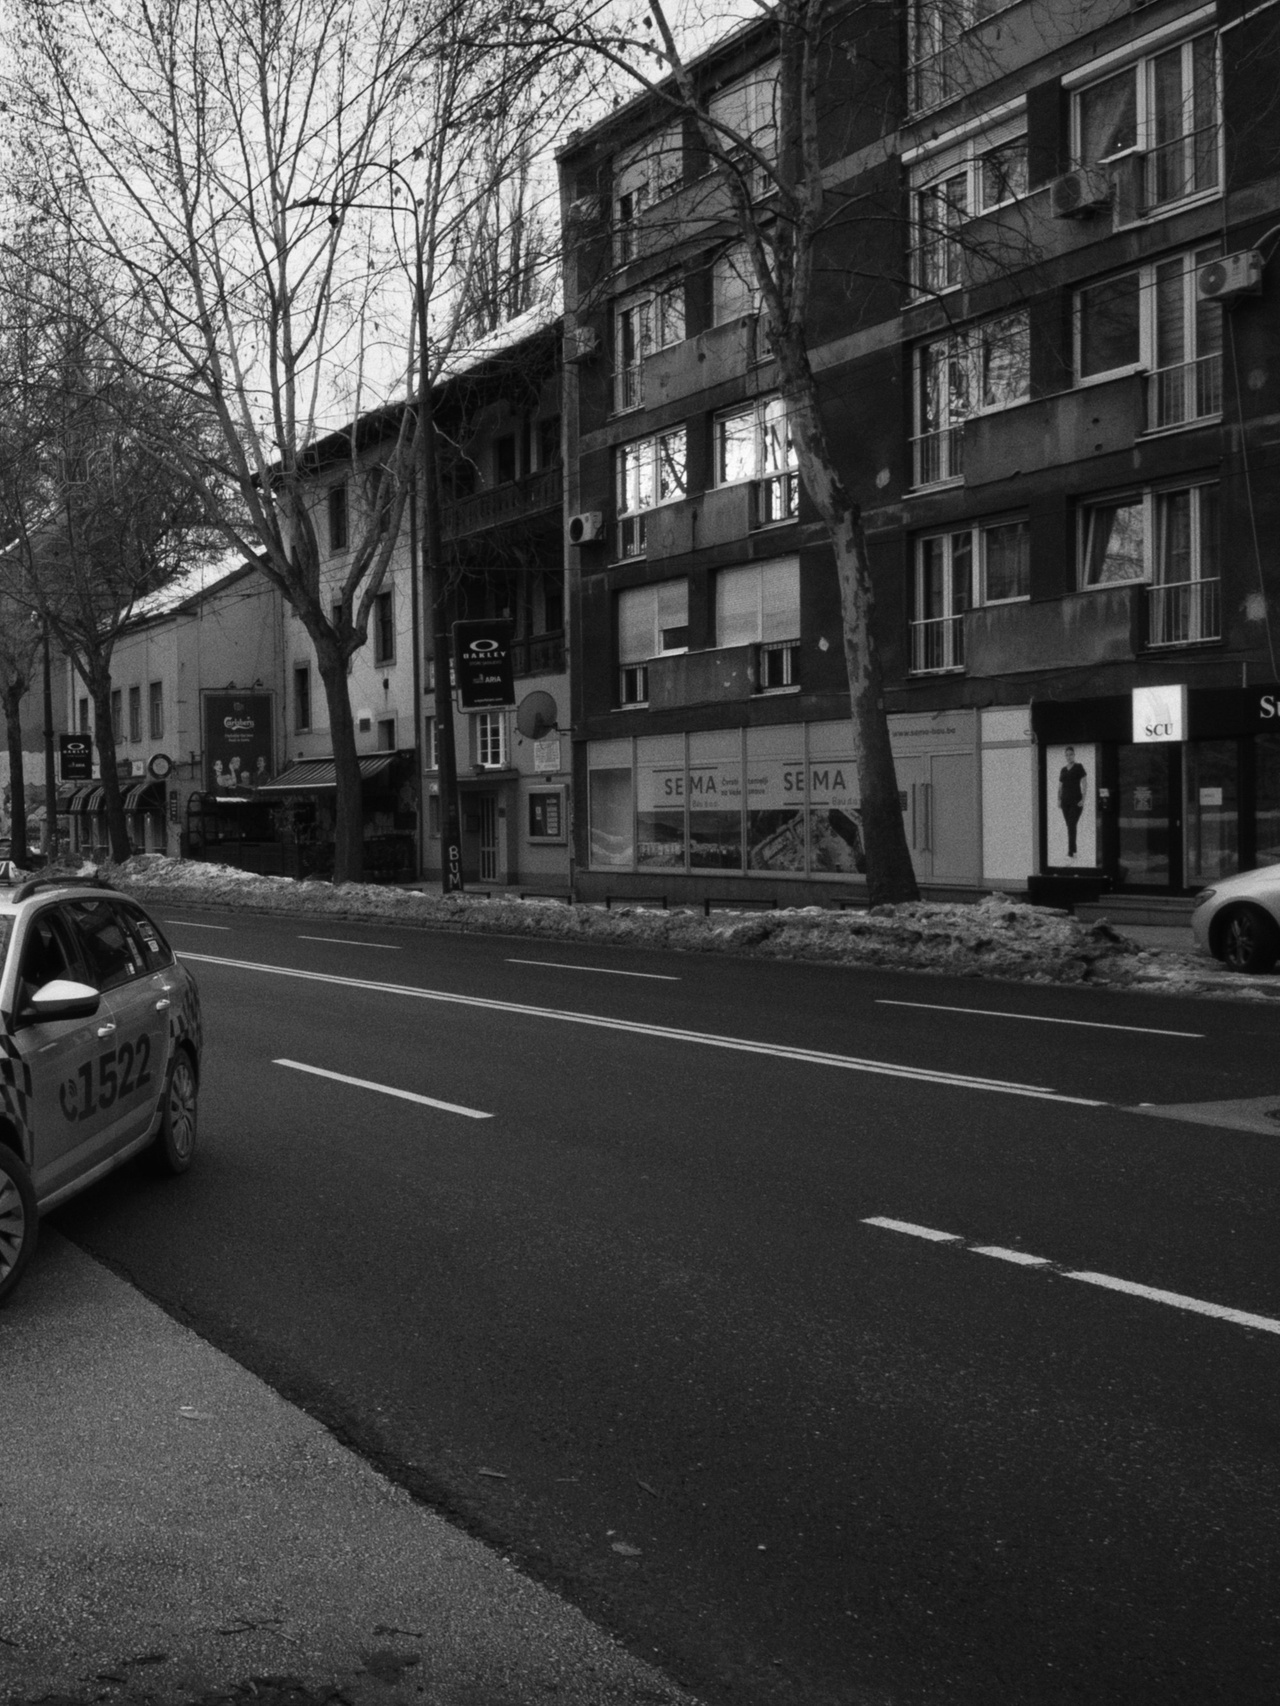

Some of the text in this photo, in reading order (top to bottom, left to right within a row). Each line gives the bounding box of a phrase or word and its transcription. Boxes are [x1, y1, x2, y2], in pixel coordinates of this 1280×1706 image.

[462, 650, 506, 659] OAKLEY
[1145, 723, 1174, 737] SCU
[664, 775, 718, 796] SEMA
[783, 769, 846, 791] SEMA
[78, 1033, 150, 1121] 1522
